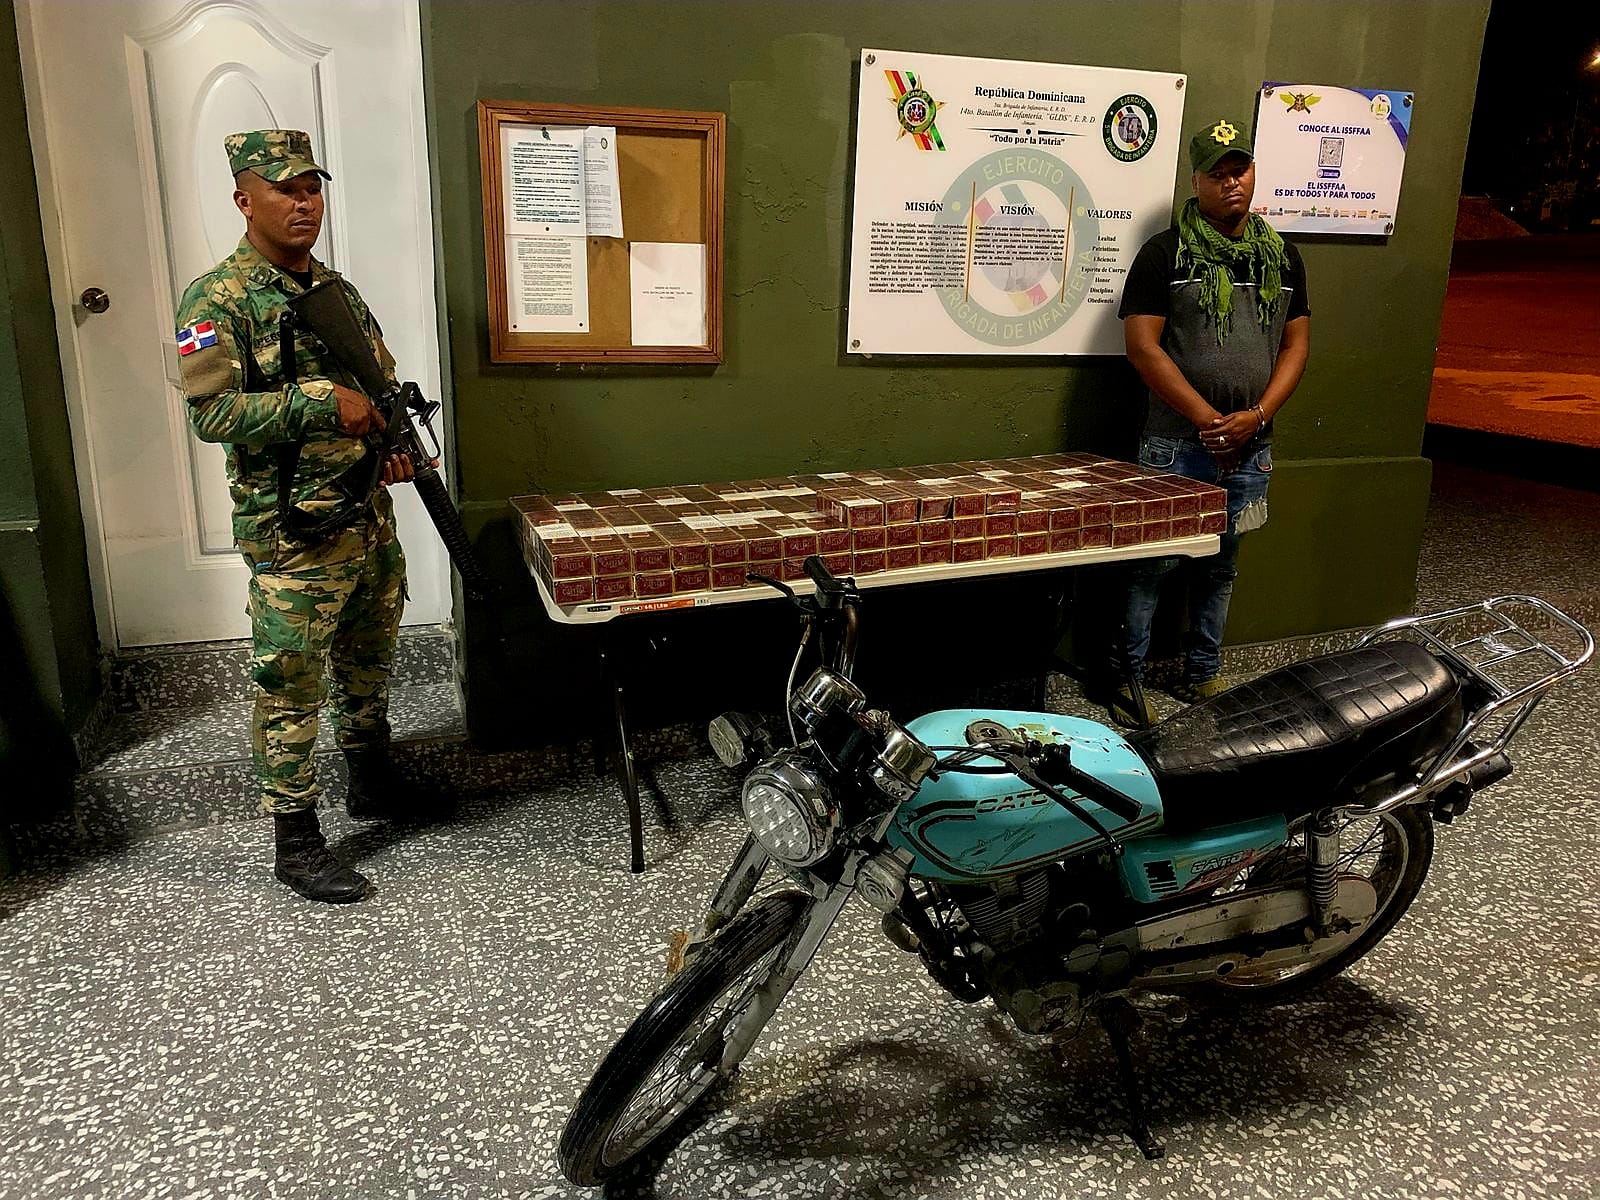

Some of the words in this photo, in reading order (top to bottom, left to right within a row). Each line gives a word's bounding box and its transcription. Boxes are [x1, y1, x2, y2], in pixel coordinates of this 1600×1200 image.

[975, 86, 1025, 99] República
[1028, 90, 1085, 103] Dominicana
[1003, 110, 1012, 118] de
[1298, 124, 1329, 134] CONOCE
[1331, 126, 1340, 134] AL
[1015, 136, 1028, 145] por
[1030, 136, 1036, 144] la
[982, 154, 1064, 185] EJERCITO
[1307, 182, 1316, 190] EL
[1285, 189, 1294, 197] DE
[1296, 189, 1321, 198] TODOS
[1329, 191, 1349, 199] PARA
[1351, 191, 1376, 200] TODOS
[905, 199, 944, 213] MISIÓN
[1000, 203, 1035, 216] VISIÓN
[1087, 209, 1132, 220] VALORES
[1003, 323, 1024, 339] DE
